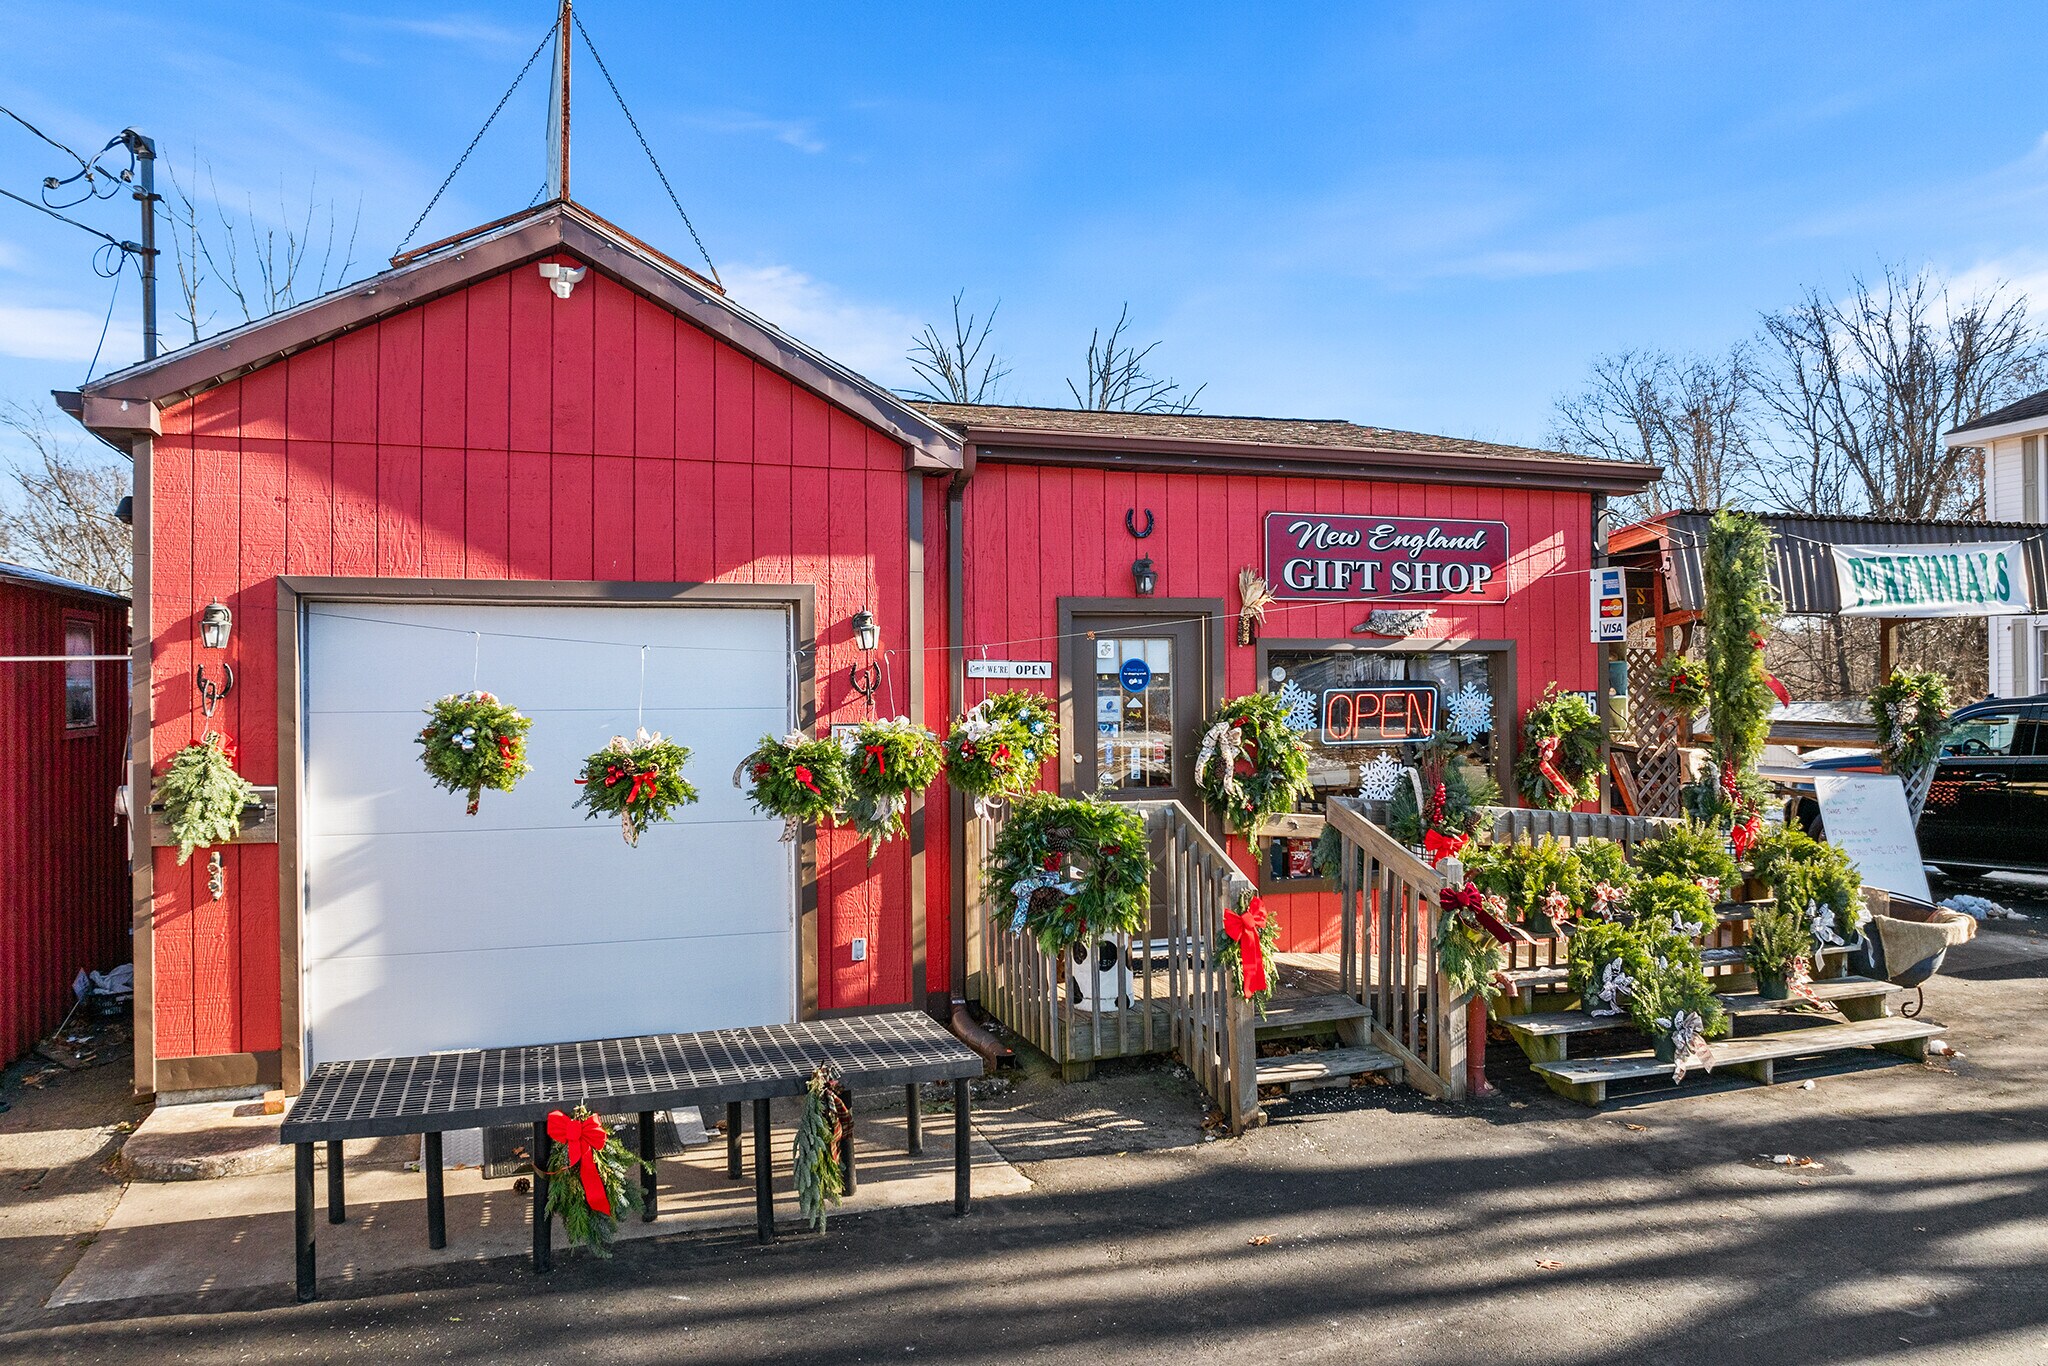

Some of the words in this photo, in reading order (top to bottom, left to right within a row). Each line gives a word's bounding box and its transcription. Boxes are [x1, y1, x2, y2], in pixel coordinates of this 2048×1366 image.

[1288, 520, 1361, 549] New
[1369, 524, 1487, 559] England
[1282, 558, 1382, 591] GIFT
[1391, 561, 1493, 594] SHOP
[1848, 552, 2011, 607] PERENNIALS
[1602, 622, 1623, 633] VISA
[987, 665, 1008, 674] WE'RE
[1015, 664, 1046, 675] OPEN
[1328, 692, 1432, 739] OPEN
